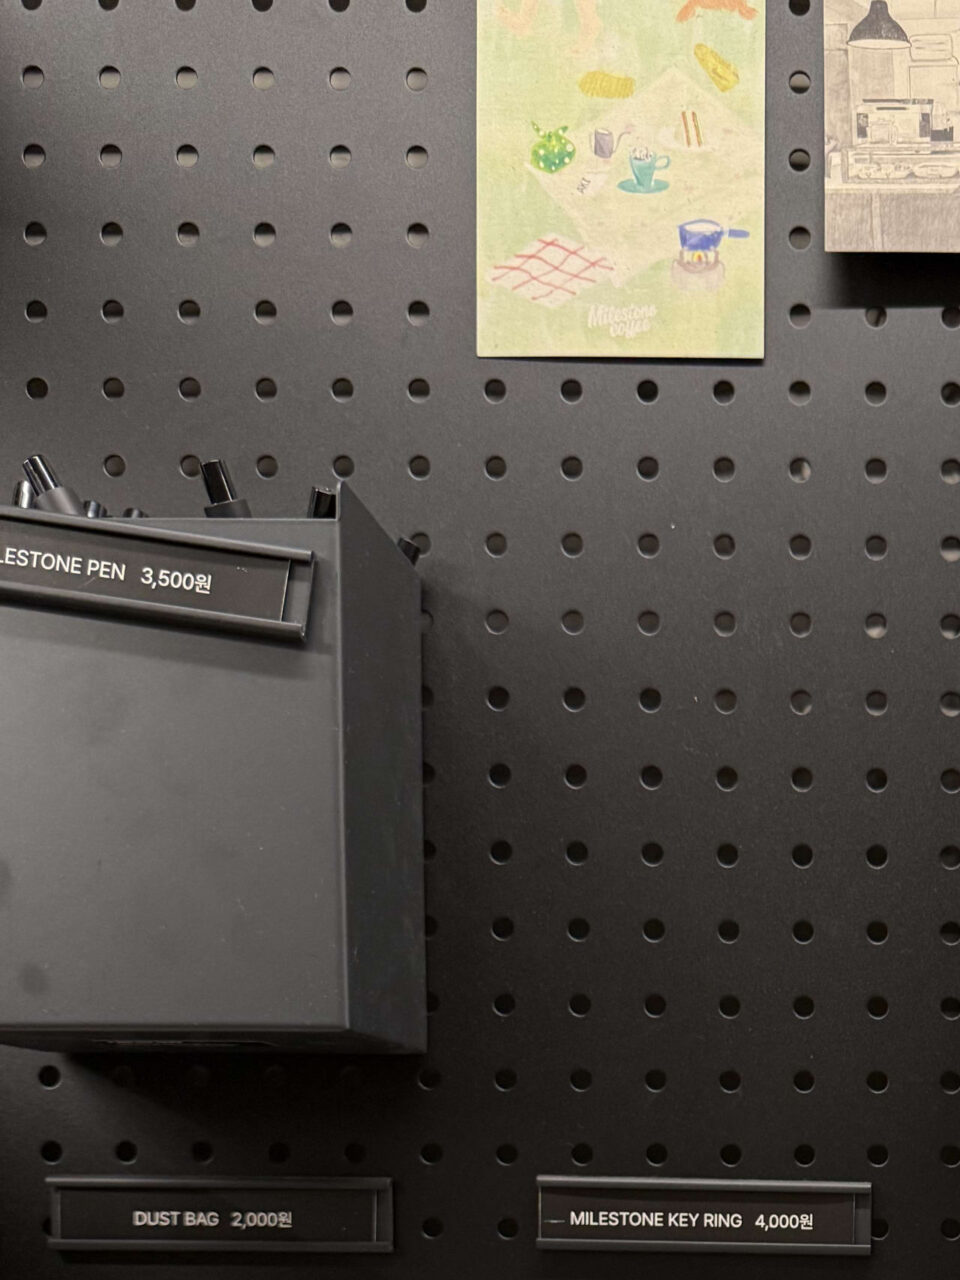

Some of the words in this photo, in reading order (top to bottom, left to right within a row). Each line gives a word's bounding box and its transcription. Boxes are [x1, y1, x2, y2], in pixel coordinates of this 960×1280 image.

[87, 558, 126, 581] PEN
[141, 567, 212, 594] 3,500원
[132, 1210, 181, 1227] DUST
[182, 1210, 220, 1227] BAG
[230, 1210, 293, 1230] 2,000원
[569, 1211, 664, 1227] MILESTONE
[668, 1212, 700, 1228] KEY
[703, 1213, 743, 1228] RING
[755, 1213, 814, 1231] 4,000원
